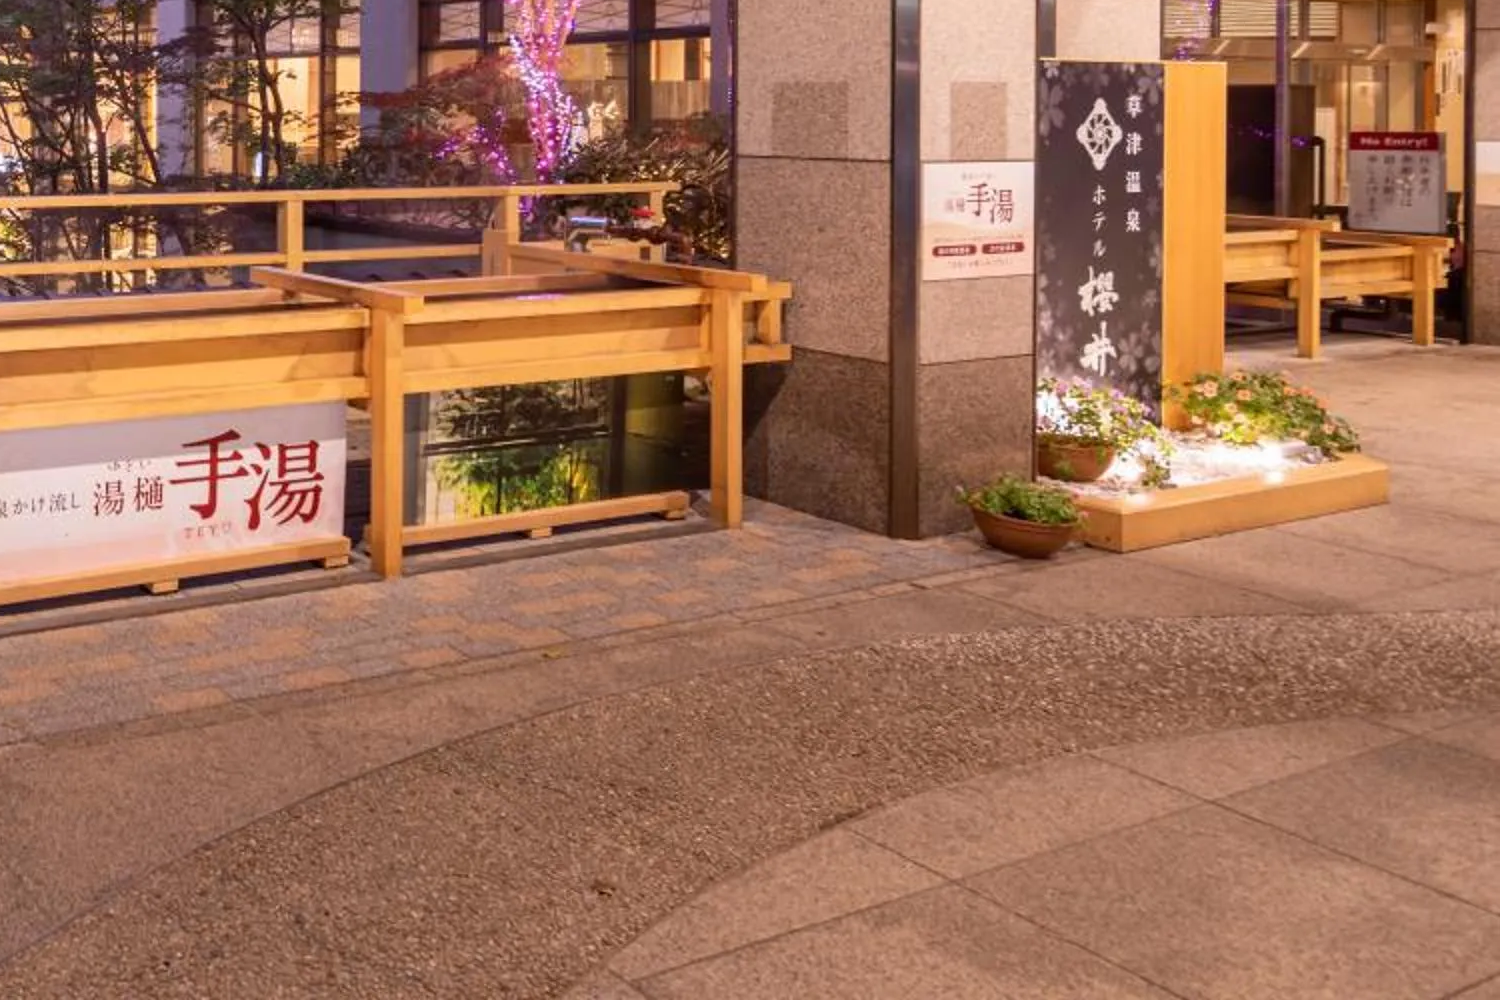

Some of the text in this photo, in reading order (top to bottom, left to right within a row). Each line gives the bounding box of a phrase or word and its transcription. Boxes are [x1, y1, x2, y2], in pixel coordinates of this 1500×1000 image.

[966, 183, 1013, 223] 手湯
[1125, 95, 1142, 232] 草津温泉
[169, 429, 324, 530] 手湯
